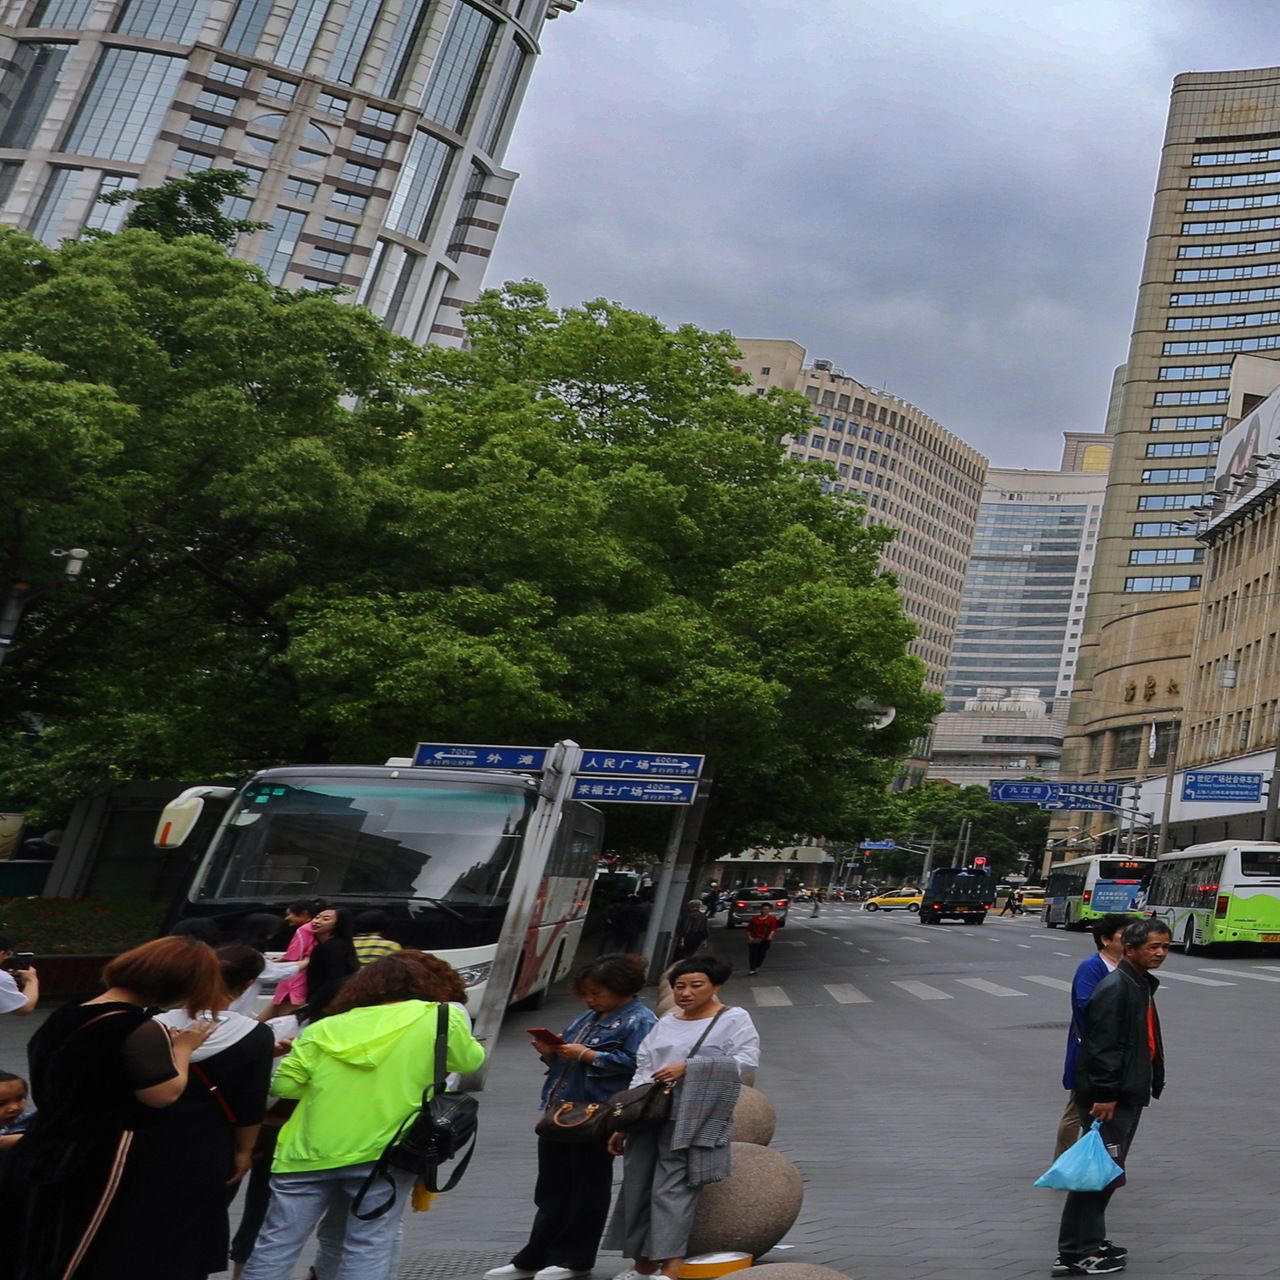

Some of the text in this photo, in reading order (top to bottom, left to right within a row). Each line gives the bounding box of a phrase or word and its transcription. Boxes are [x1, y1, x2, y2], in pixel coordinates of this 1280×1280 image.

[486, 752, 535, 765] 外滩
[585, 757, 650, 770] 人民广场
[577, 784, 643, 797] 来福士广场
[1008, 786, 1042, 794] 九江路
